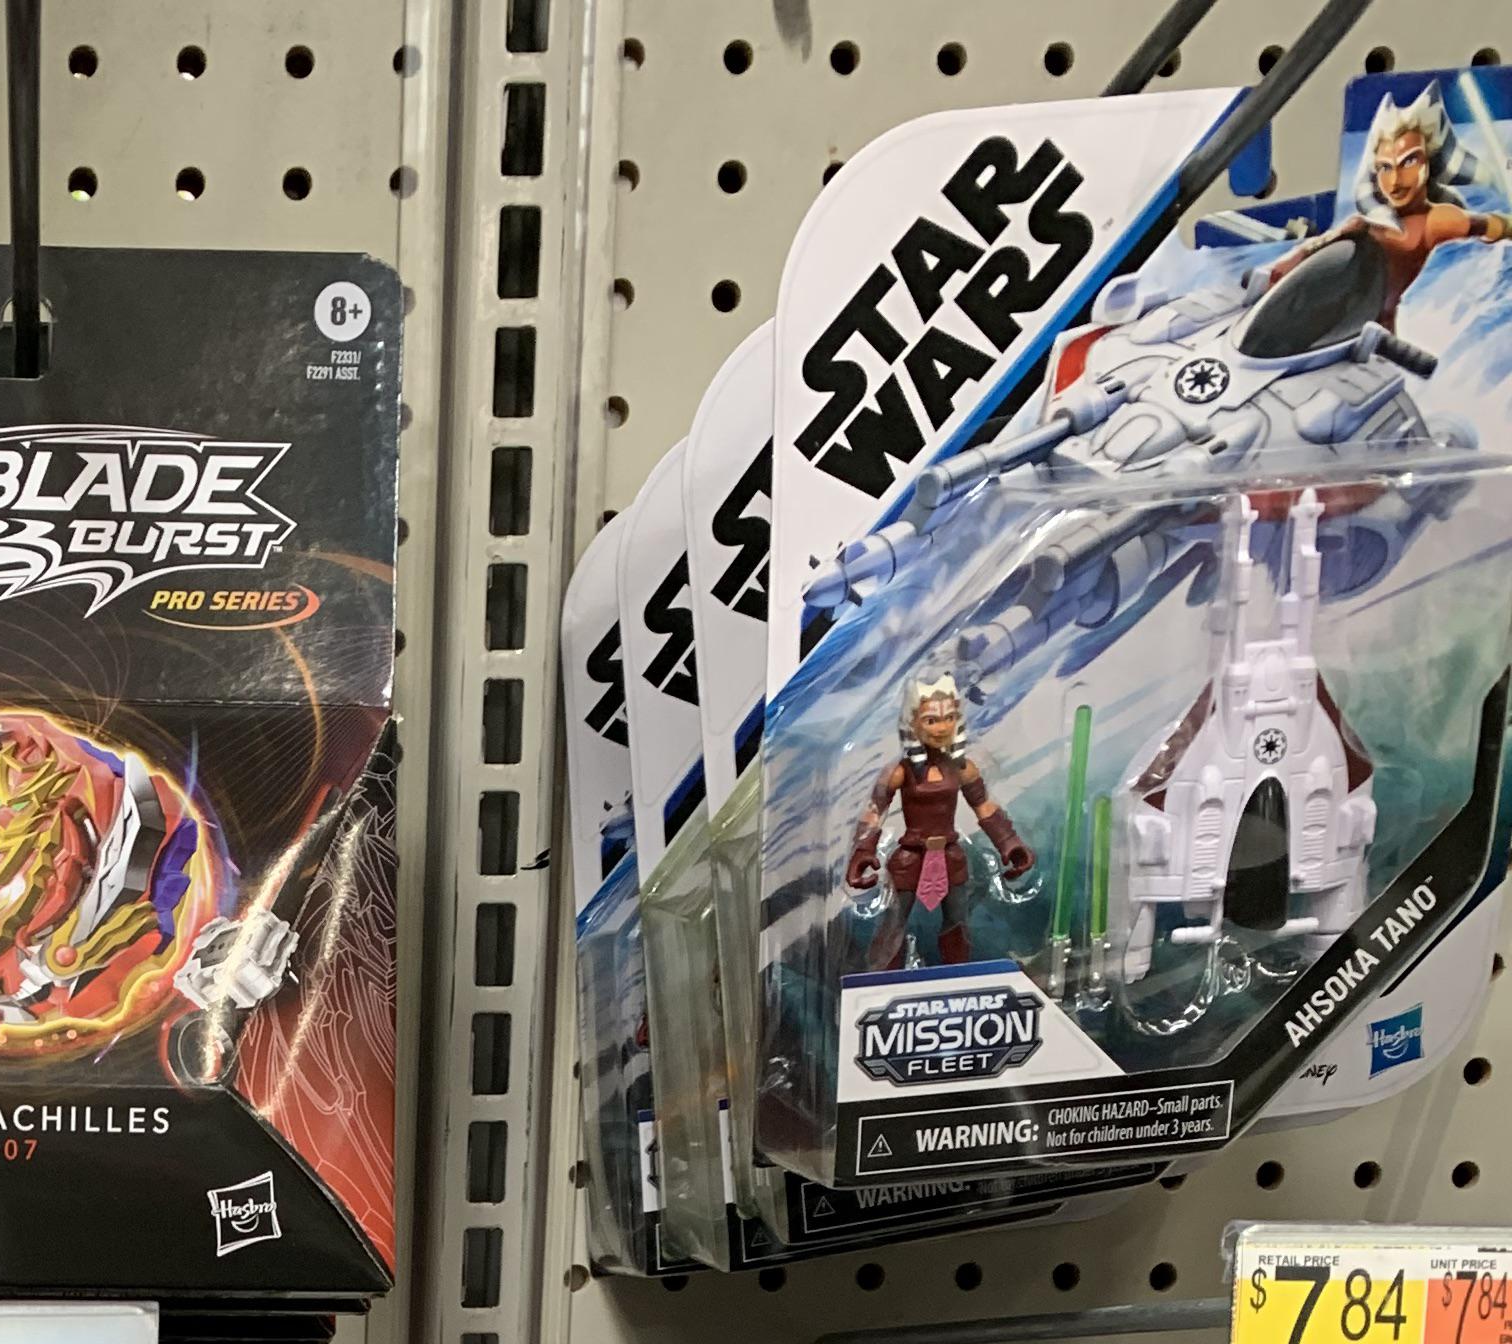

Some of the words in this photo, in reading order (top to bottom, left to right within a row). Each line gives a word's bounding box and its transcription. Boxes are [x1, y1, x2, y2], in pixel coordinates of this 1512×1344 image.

[331, 296, 363, 326] 8+
[795, 134, 1063, 461] STAR
[813, 162, 1094, 499] WARS
[307, 366, 333, 379] F2291
[68, 518, 280, 562] BURST
[151, 590, 206, 611] PRO
[212, 591, 299, 612] SERIES
[1284, 948, 1380, 1048] AHSOKA
[1370, 884, 1437, 951] TANO
[865, 1010, 1033, 1058] MISSION
[907, 1054, 992, 1076] FLEET
[916, 1119, 1038, 1152] WARNING:
[1048, 1105, 1100, 1125] CHOKING
[1191, 1094, 1223, 1114] parts.
[1047, 1132, 1067, 1147] Not
[1070, 1130, 1086, 1145] for
[1088, 1124, 1133, 1143] children
[1136, 1122, 1168, 1139] under
[1172, 1122, 1179, 1135] 3
[1181, 1118, 1214, 1137] years.
[219, 1198, 277, 1221] Hasbro
[1259, 1255, 1300, 1266] RETAIL
[1304, 1256, 1339, 1266] PRICE
[1431, 1259, 1457, 1270] UNIT
[1462, 1259, 1497, 1270] PRICE
